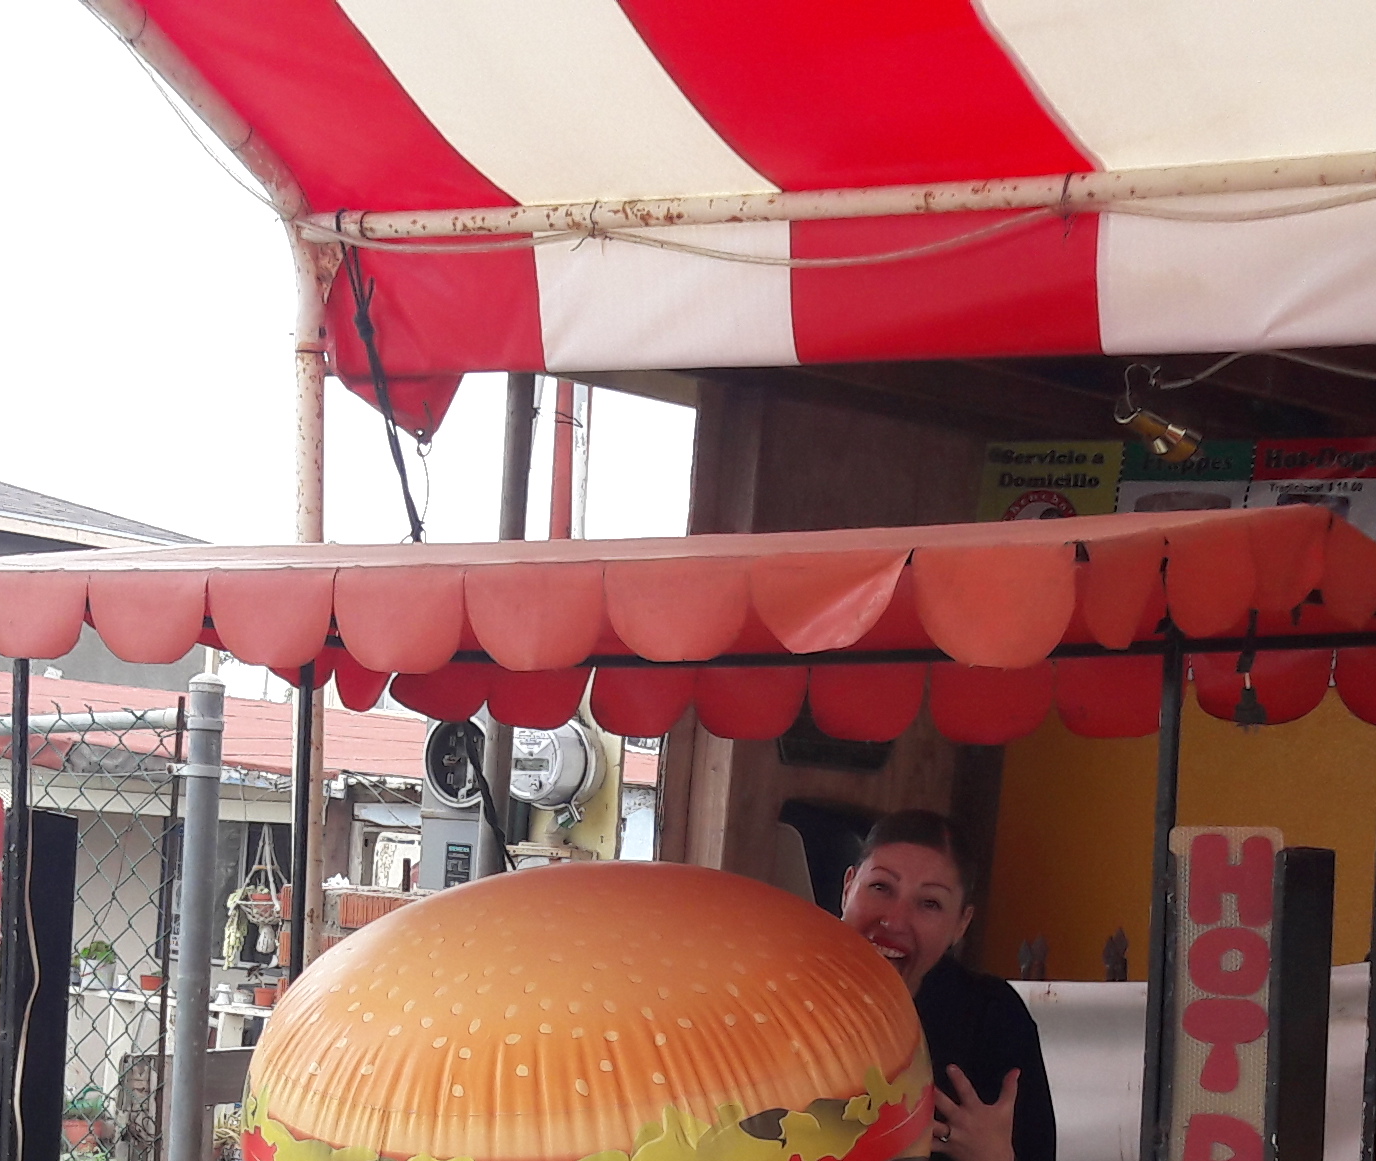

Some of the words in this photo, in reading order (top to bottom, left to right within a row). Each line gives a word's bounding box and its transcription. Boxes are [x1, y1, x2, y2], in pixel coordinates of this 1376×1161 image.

[1001, 449, 1087, 466] Servicio
[1092, 453, 1104, 465] a
[1181, 833, 1275, 1094] HOT
